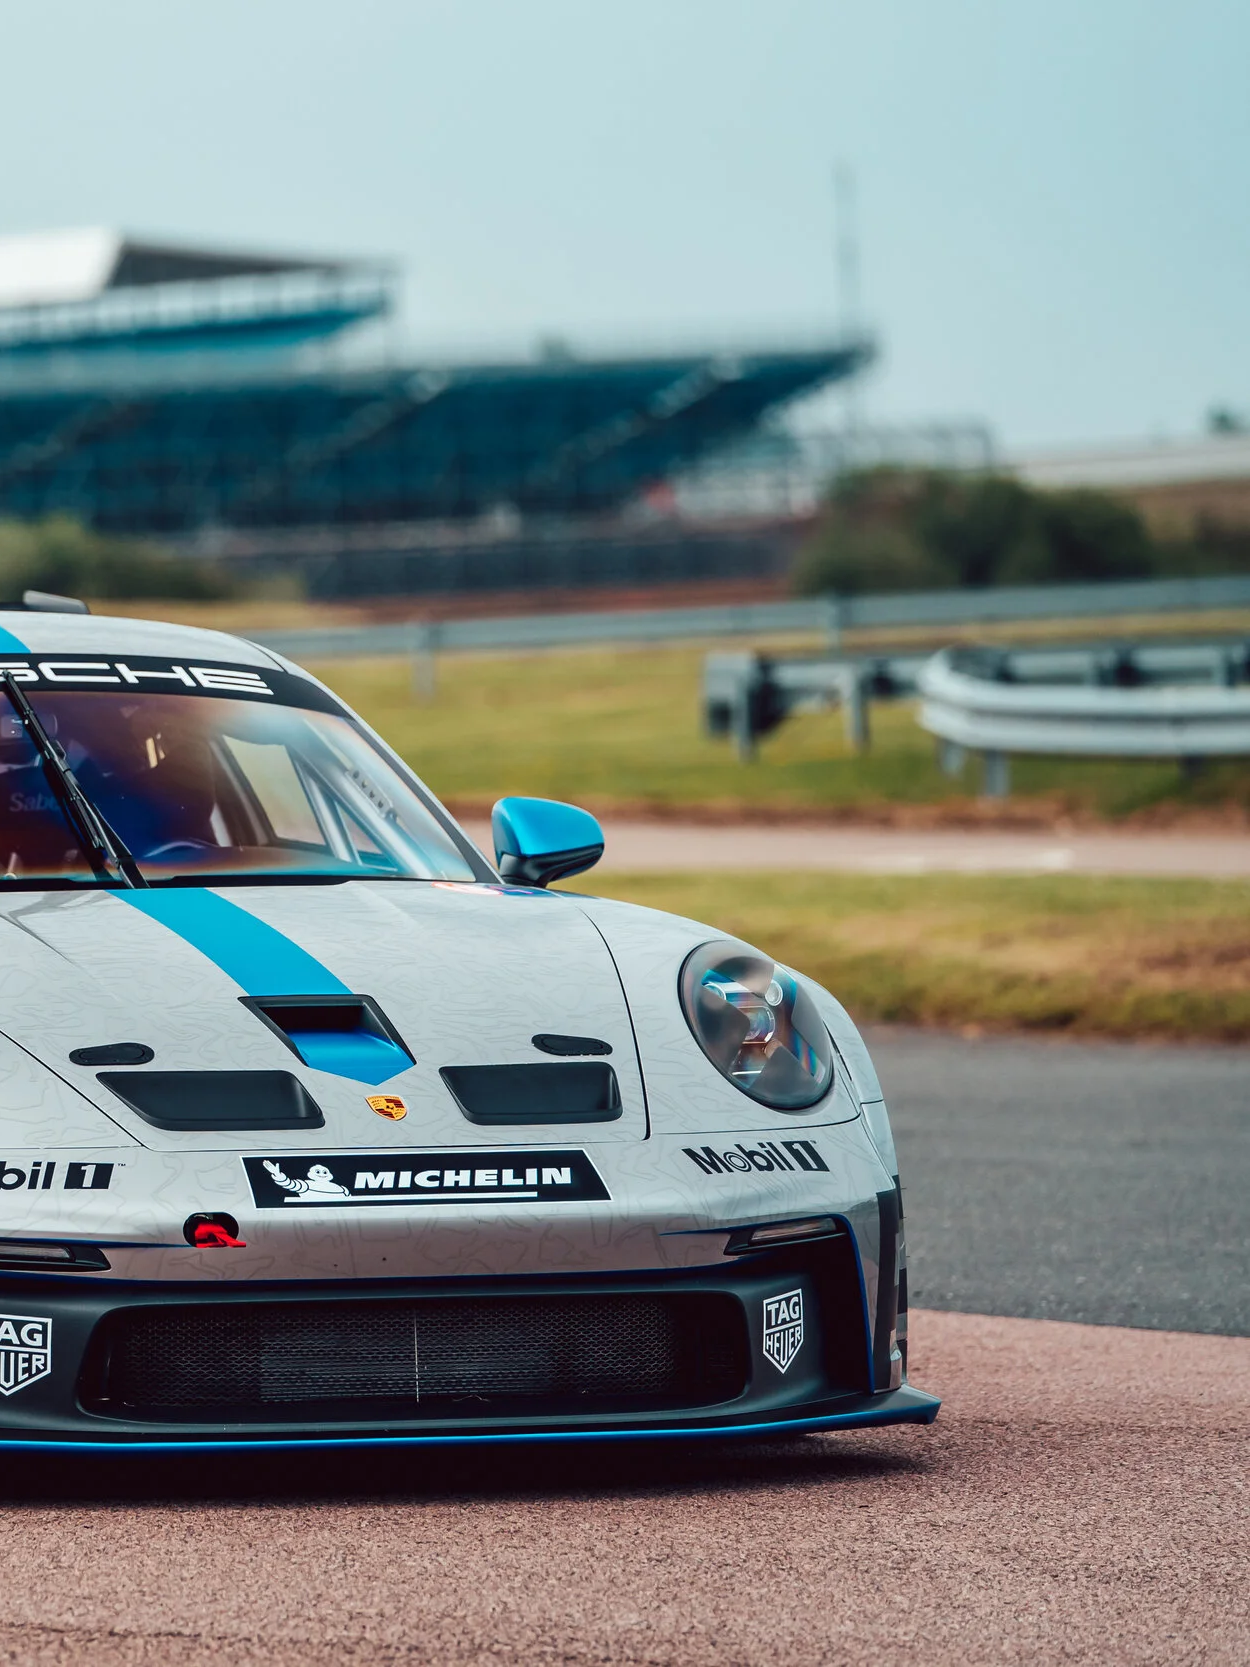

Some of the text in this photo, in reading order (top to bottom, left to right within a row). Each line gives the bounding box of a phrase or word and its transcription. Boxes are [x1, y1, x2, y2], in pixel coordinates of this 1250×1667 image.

[681, 1141, 796, 1175] Mobil
[353, 1166, 573, 1190] MICHELIN
[767, 1295, 801, 1327] TAG
[766, 1325, 801, 1368] HEUER
